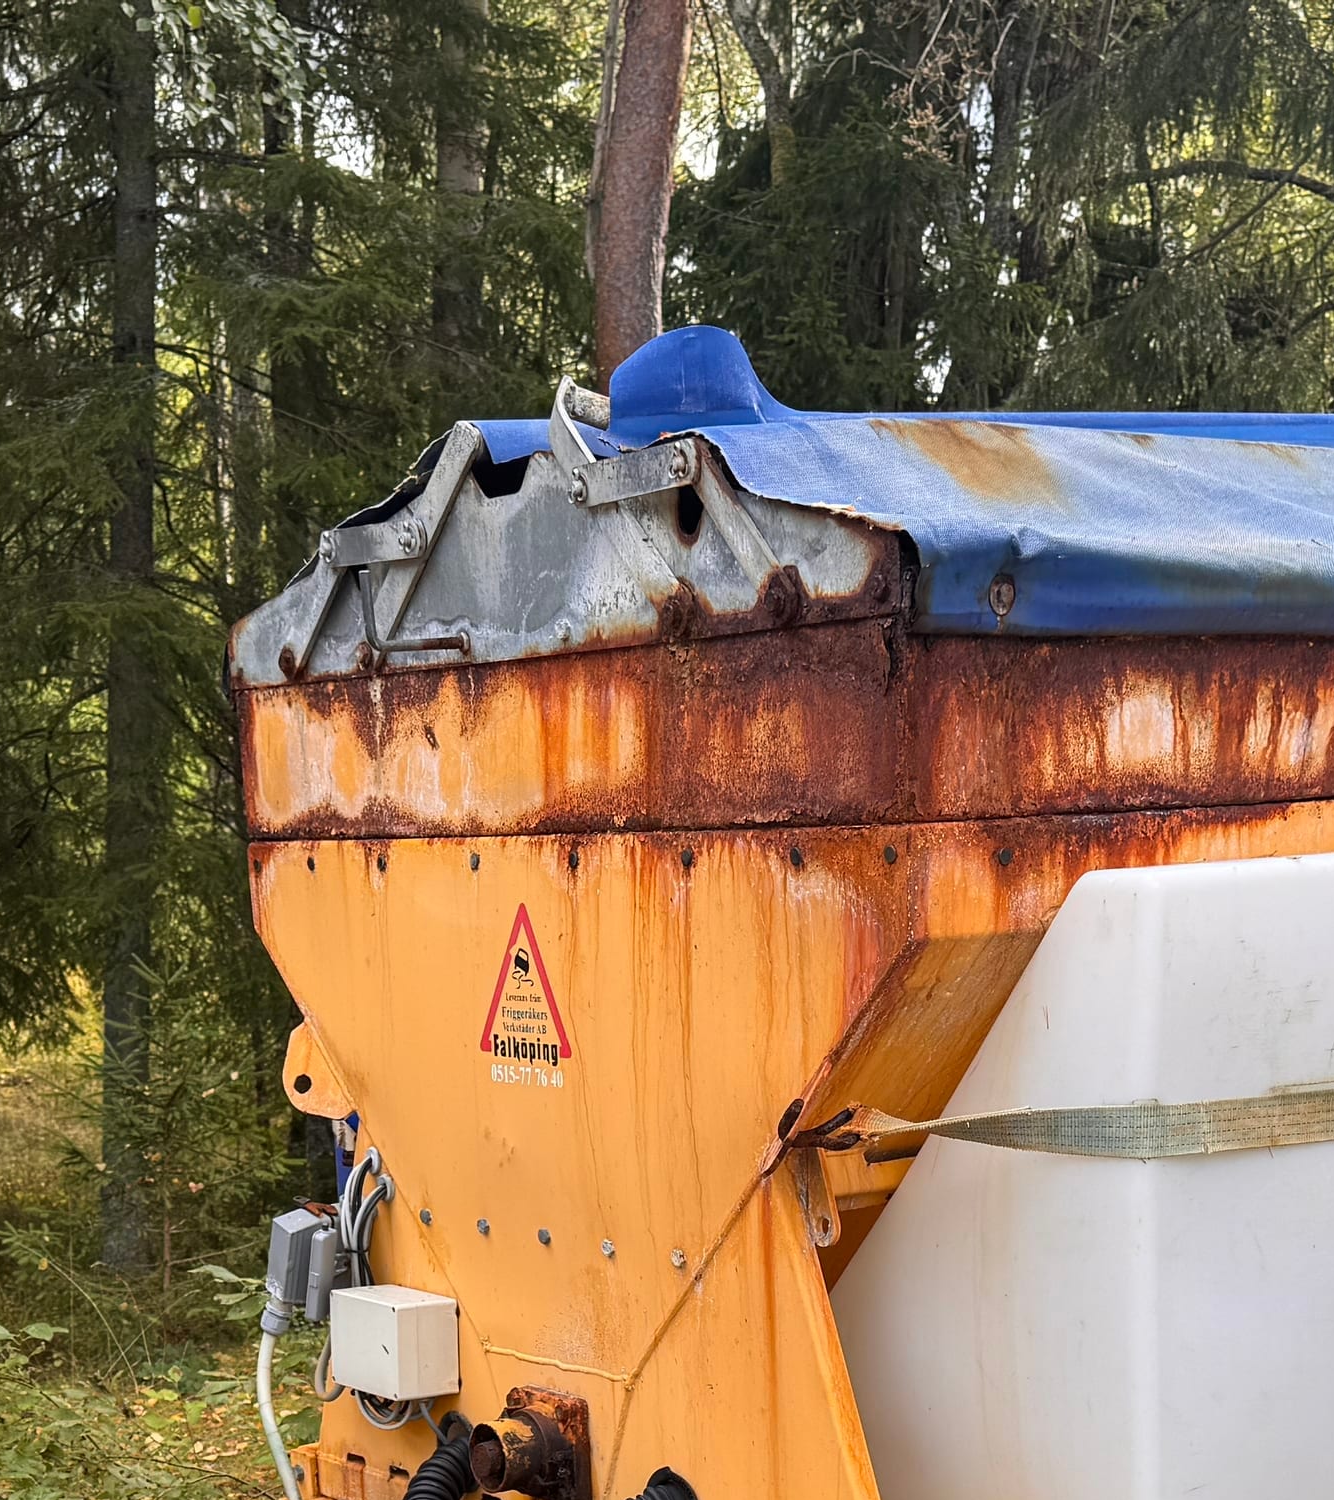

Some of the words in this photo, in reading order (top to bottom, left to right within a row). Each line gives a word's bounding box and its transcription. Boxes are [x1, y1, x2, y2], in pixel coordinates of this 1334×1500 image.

[536, 1024, 547, 1035] AB
[493, 1033, 558, 1067] Falköping
[491, 1063, 532, 1086] 0515-77
[534, 1067, 548, 1088] 76
[550, 1070, 564, 1089] 40
